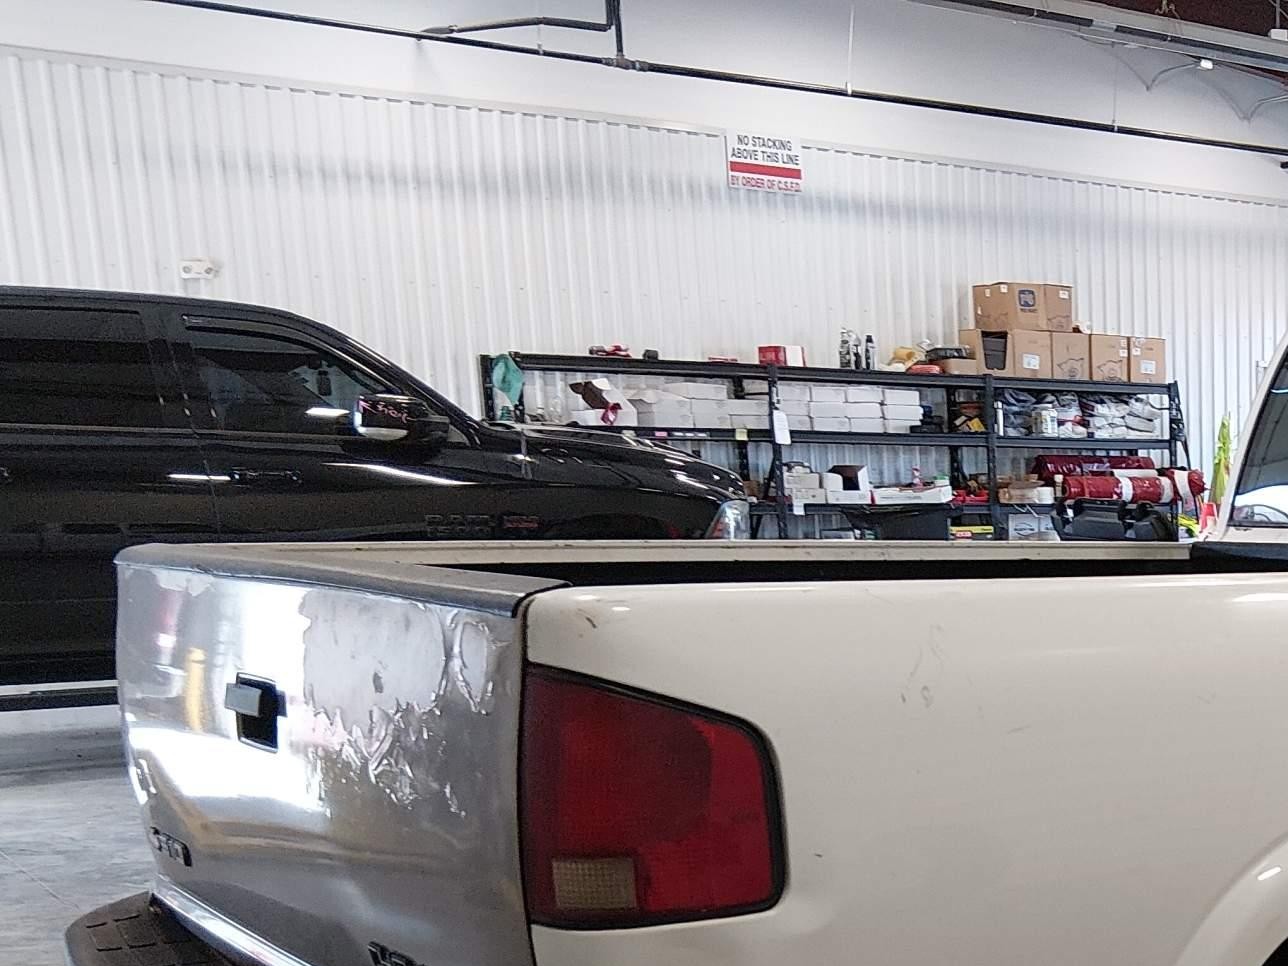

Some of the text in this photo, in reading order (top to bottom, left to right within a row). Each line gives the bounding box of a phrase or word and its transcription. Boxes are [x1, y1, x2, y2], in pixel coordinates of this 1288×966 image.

[737, 135, 792, 152] NO STACKING
[731, 147, 800, 166] ABOVE THIS LINE
[731, 175, 740, 186] BY
[741, 176, 765, 188] ORDER
[767, 179, 777, 190] OF
